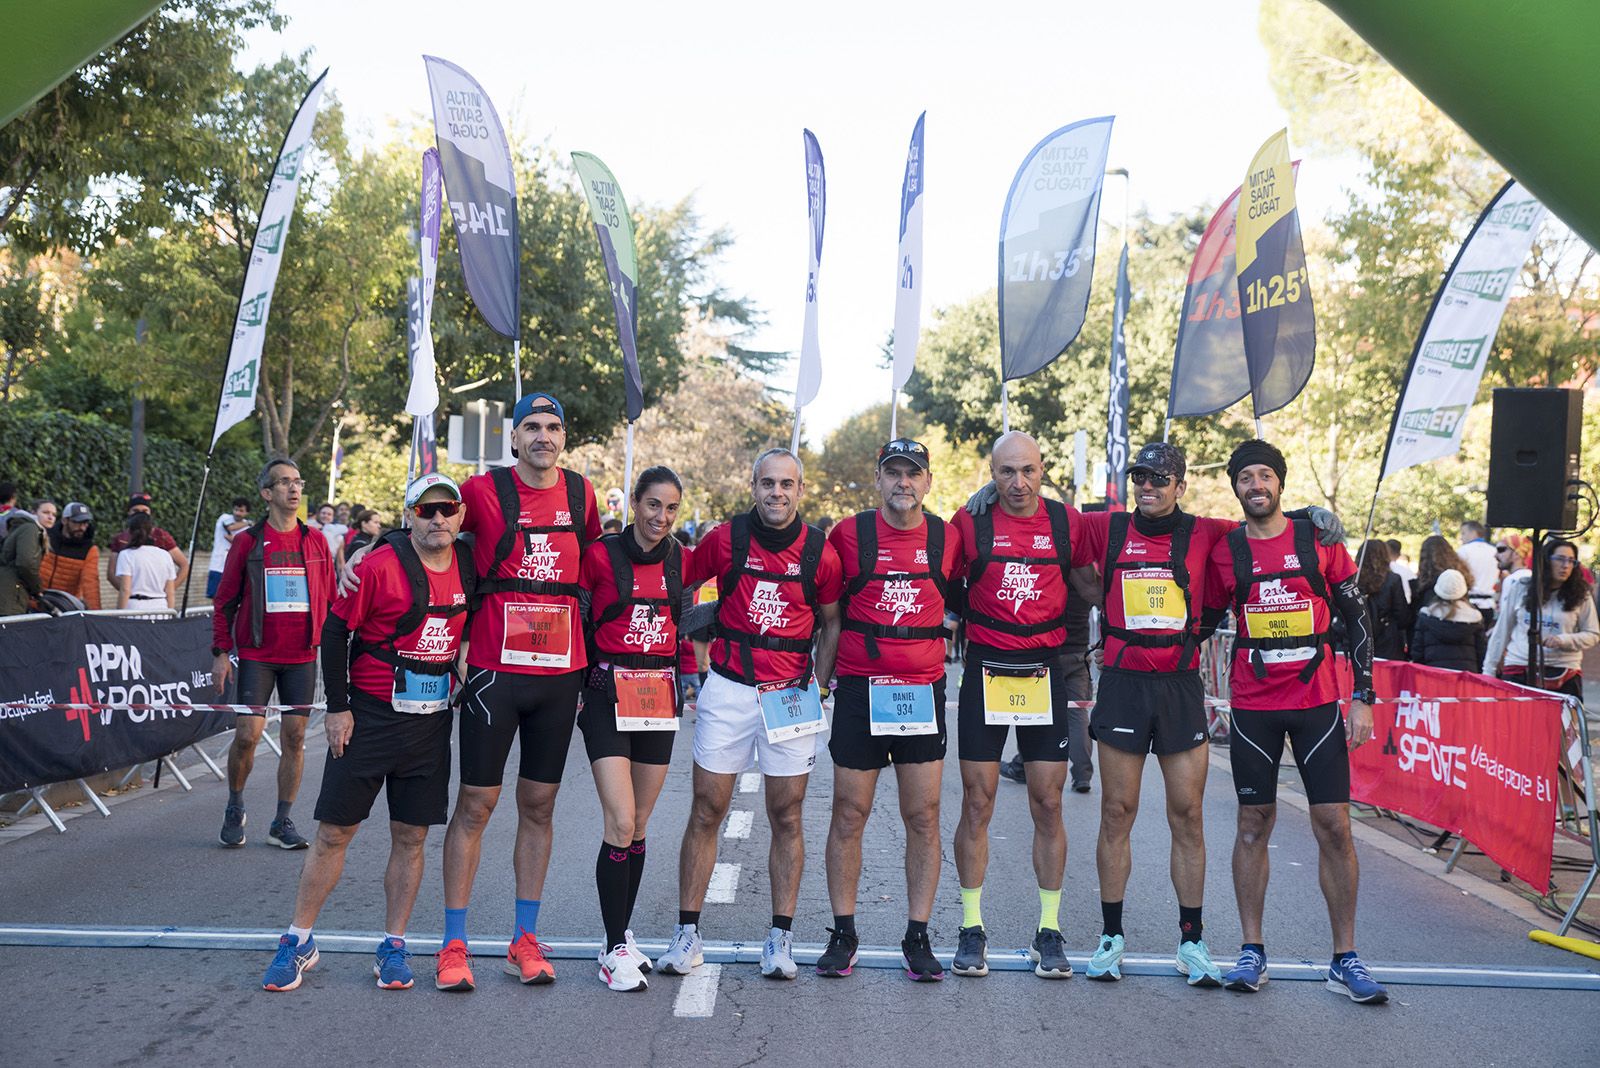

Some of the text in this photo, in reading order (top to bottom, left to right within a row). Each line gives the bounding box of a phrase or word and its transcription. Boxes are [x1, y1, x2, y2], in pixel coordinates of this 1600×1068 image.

[1041, 147, 1089, 161] MITJA
[1041, 161, 1087, 176] SANT
[1249, 168, 1276, 187] MITJA
[1034, 177, 1091, 191] CUGAT
[1251, 183, 1275, 203] SANT
[1248, 197, 1281, 220] CUGAT
[1188, 289, 1241, 321] 1h3
[522, 555, 559, 567] SANT
[517, 568, 563, 580] CUGAT
[1009, 564, 1032, 575] 21K
[1001, 577, 1037, 588] SANT
[757, 589, 782, 602] 21K
[882, 591, 917, 602] SANT
[996, 590, 1042, 601] CUGAT
[1147, 586, 1167, 595] JOSEP
[1263, 585, 1287, 597] 21K
[749, 601, 785, 614] SANT
[875, 602, 923, 614] CUGAT
[1149, 597, 1164, 609] 919
[636, 608, 657, 619] 21
[529, 621, 552, 631] ALBERT
[629, 620, 667, 632] SANT
[1268, 619, 1289, 629] ORIOL
[427, 626, 451, 638] 21K
[417, 638, 450, 651] SANT
[531, 633, 547, 646] 924
[623, 633, 668, 645] CUGAT
[86, 644, 145, 682] RPM
[421, 682, 438, 694] 1155
[637, 687, 657, 695] MARIA
[893, 692, 915, 702] DANIEL
[1009, 694, 1026, 706] 973
[787, 705, 803, 718] 921
[896, 703, 913, 716] 934
